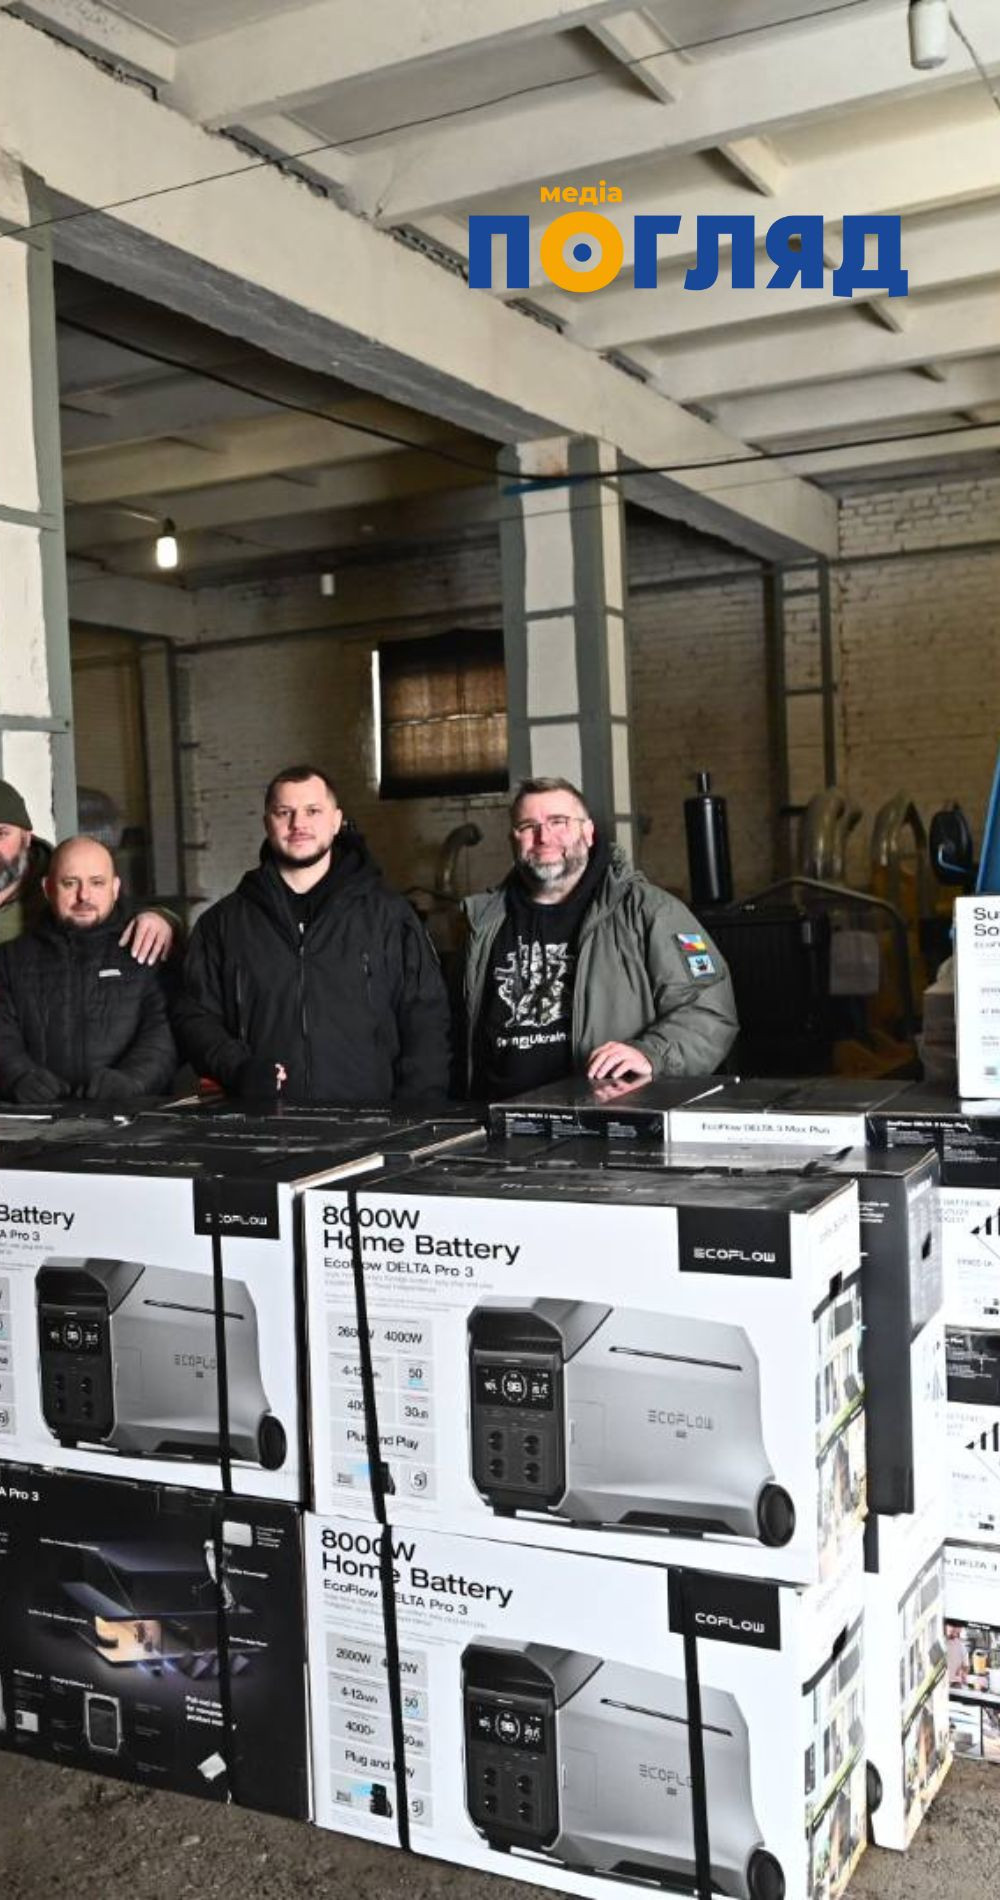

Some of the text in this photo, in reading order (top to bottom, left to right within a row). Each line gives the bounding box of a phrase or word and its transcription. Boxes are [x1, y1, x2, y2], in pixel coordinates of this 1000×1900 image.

[702, 1121, 742, 1131] EcoFlow
[744, 1122, 773, 1132] DELTA
[785, 1124, 806, 1133] Max
[809, 1124, 830, 1134] Plus
[322, 1205, 421, 1231] 8000W
[9, 1229, 30, 1241] Pro
[31, 1230, 41, 1241] 3
[415, 1234, 521, 1266] Battery
[693, 1246, 777, 1263] ECOFLOW
[386, 1260, 431, 1275] DELTA
[434, 1264, 460, 1278] Pro
[464, 1266, 475, 1278] 3
[337, 1325, 423, 1344] 260W 4000W
[173, 1354, 217, 1371] ECOFLO
[408, 1367, 423, 1379] 50
[647, 1409, 714, 1431] ECOFLOW
[379, 1433, 394, 1446] nd
[395, 1434, 419, 1451] Play
[9, 1487, 29, 1501] Pro
[31, 1490, 40, 1502] 3
[321, 1528, 416, 1563] 8000W
[323, 1578, 469, 1616] EcoFlow ELTA Pro 3
[410, 1566, 514, 1609] Battery
[694, 1612, 766, 1634] COFLOW
[336, 1647, 372, 1665] 2600W
[344, 1749, 391, 1771] Plug and
[638, 1763, 694, 1788] ECOFLO
